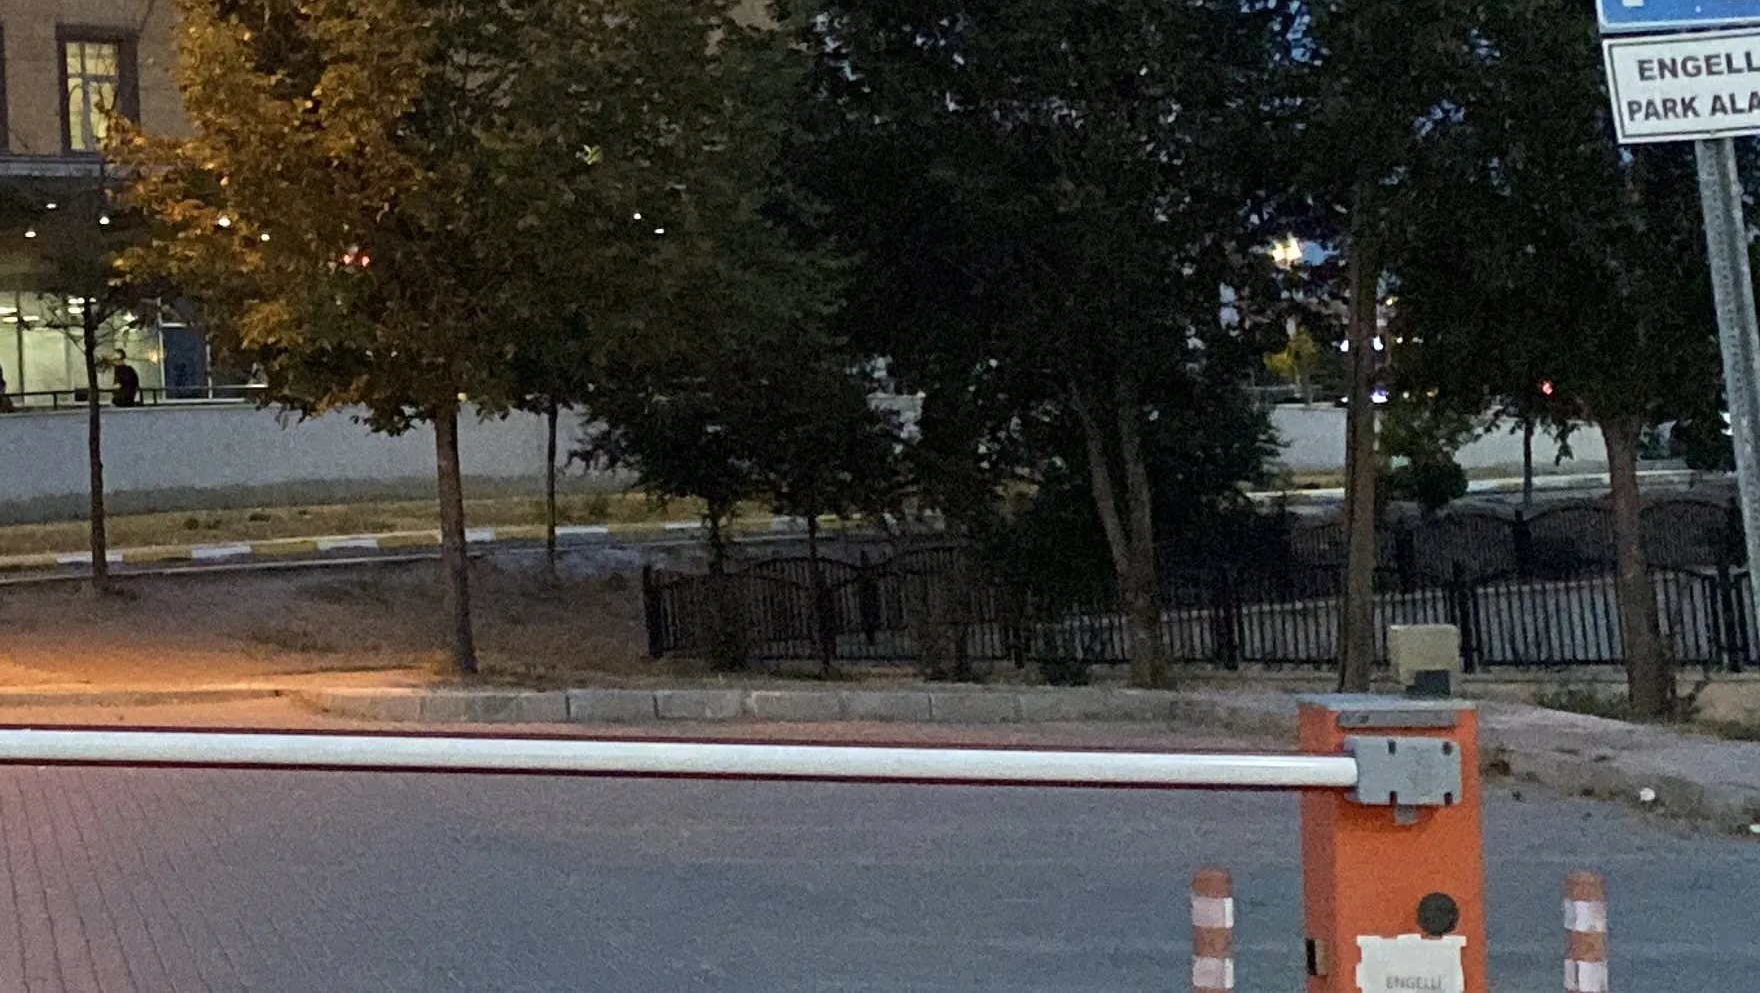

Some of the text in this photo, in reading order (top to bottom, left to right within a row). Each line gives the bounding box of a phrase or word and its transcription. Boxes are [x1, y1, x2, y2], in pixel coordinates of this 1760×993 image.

[1637, 51, 1760, 82] ENGELL
[1627, 91, 1760, 122] PARK ALA
